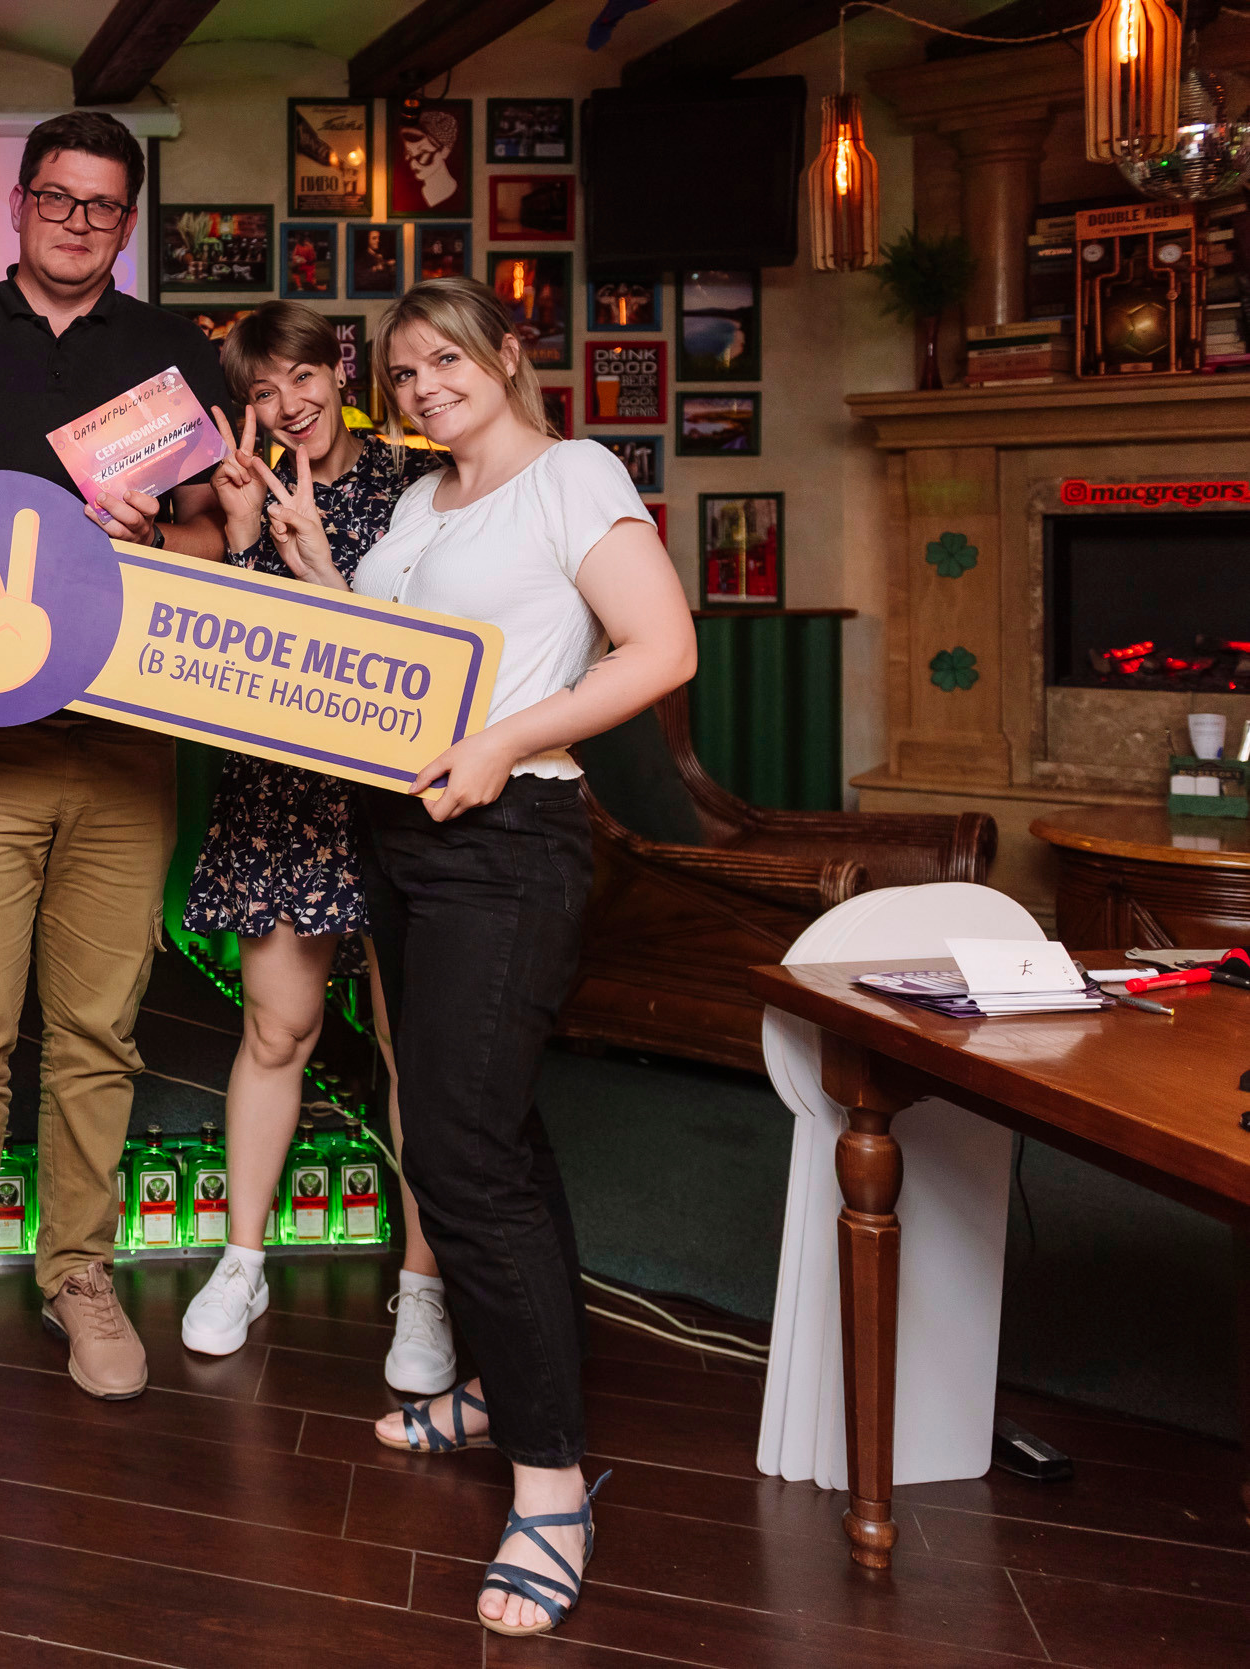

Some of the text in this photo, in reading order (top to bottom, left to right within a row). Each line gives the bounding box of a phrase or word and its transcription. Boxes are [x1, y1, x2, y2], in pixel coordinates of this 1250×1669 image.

[1088, 208, 1140, 227] DOUBLE
[595, 349, 657, 360] DRINK
[595, 361, 658, 374] GOOD
[94, 412, 172, 462] СЕРТИФИКАТ
[101, 452, 142, 480] КВЕНТИН
[144, 443, 156, 456] НА
[147, 601, 432, 701] ВТОРОЕ МЕСТО
[138, 642, 423, 743] (В ЗАЧЁТЕ НАОБОРОТ)
